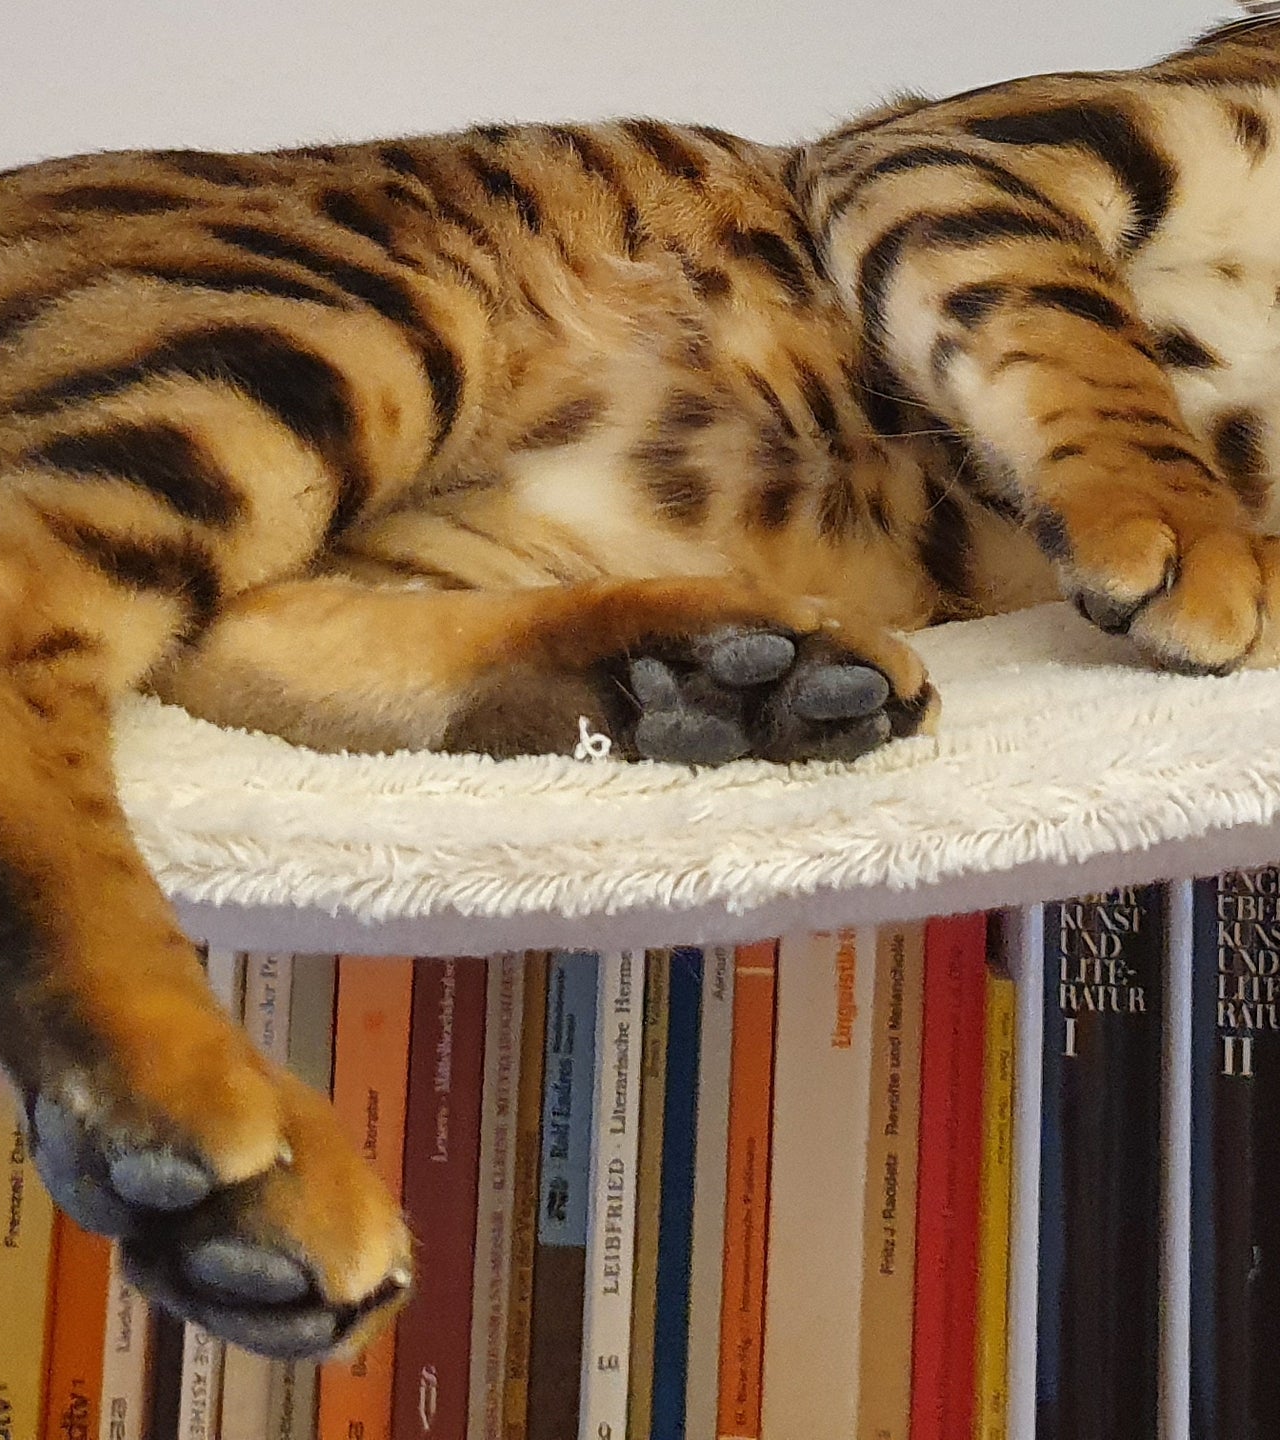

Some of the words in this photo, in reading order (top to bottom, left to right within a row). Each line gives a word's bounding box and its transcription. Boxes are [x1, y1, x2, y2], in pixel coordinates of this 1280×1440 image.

[1060, 904, 1140, 934] KUNST
[1060, 930, 1123, 958] UND
[1218, 947, 1280, 975] UND
[613, 951, 633, 1014] Herme
[1059, 956, 1138, 986] LITE-
[1060, 984, 1147, 1013] RATUR
[1222, 1035, 1255, 1077] II
[609, 1022, 631, 1136] Literarische
[878, 1238, 896, 1277] Fritz
[887, 1036, 902, 1068] und
[601, 1158, 625, 1296] LEIBFRIED
